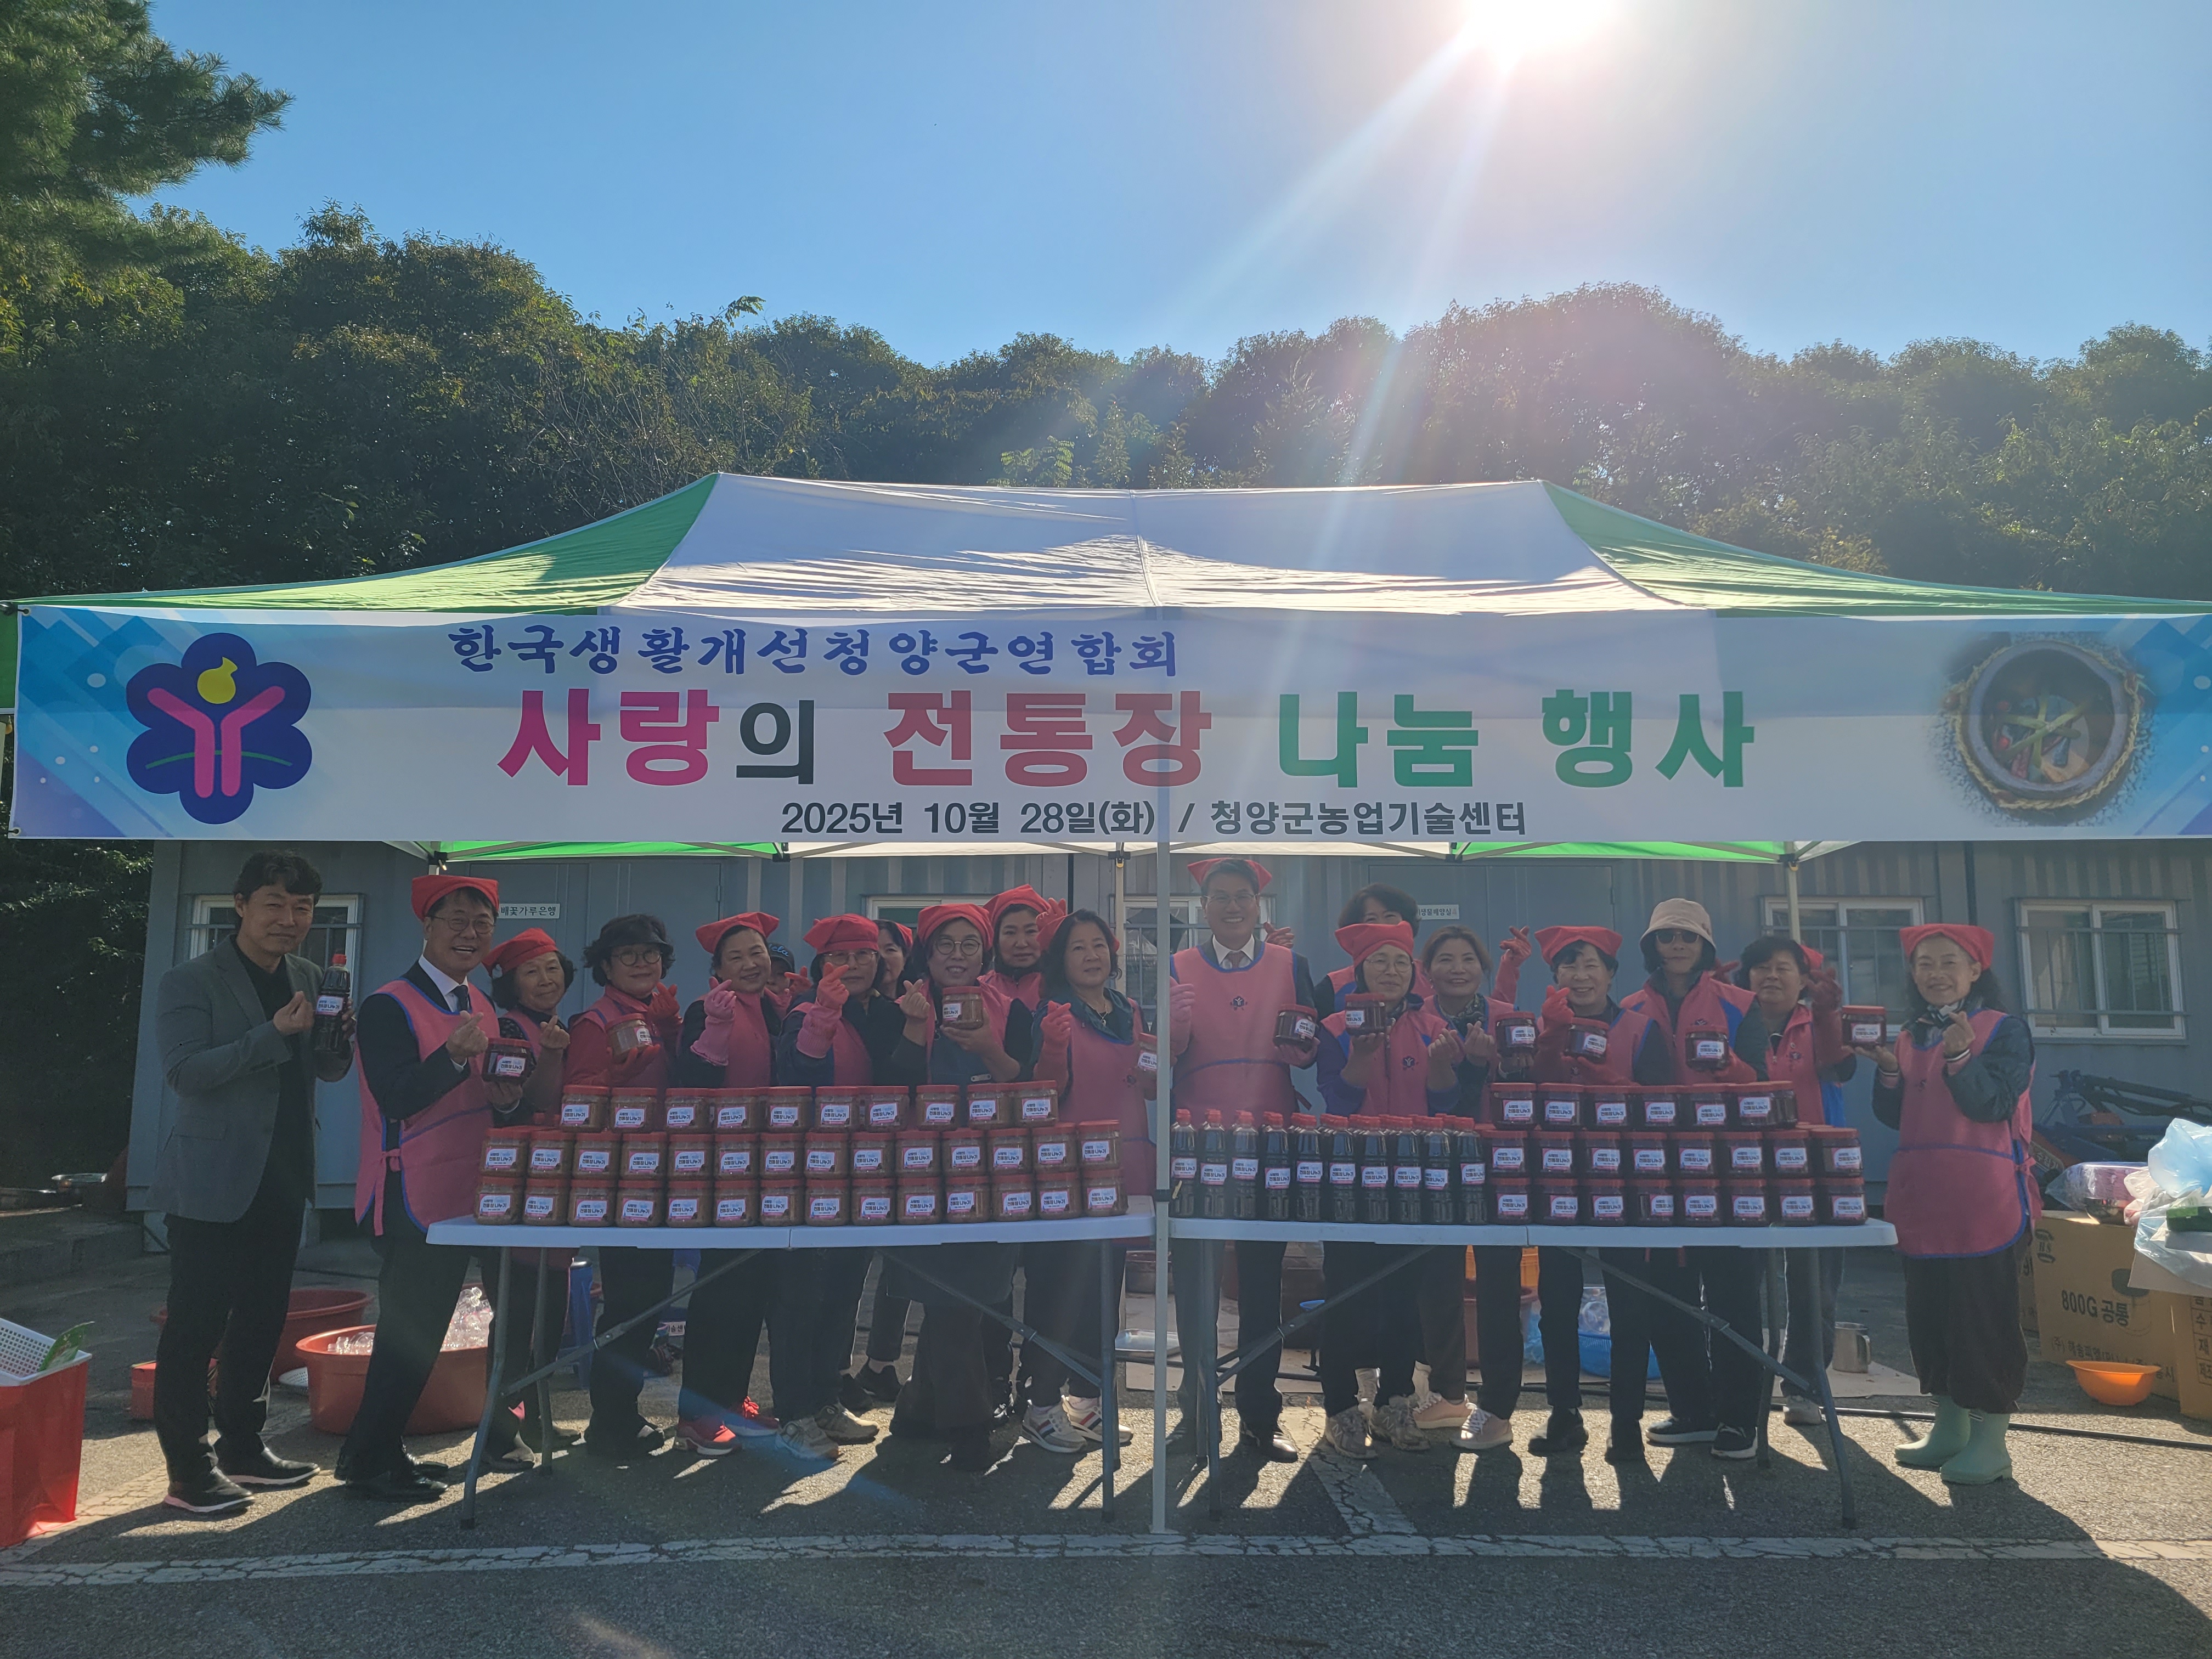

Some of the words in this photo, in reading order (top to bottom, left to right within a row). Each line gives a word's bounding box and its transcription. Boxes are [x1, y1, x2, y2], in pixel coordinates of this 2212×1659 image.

[496, 688, 815, 786] 사랑의
[883, 690, 1212, 787] 전통장
[1279, 690, 1479, 788] 나눔
[1541, 689, 1755, 788] 행사
[781, 802, 903, 834] 2025년
[924, 802, 1000, 834] 10월
[1019, 800, 1155, 836] 28일(화)
[1209, 800, 1527, 836] 청양군농업기술센터
[500, 906, 556, 916] 배꽃가루은행
[2062, 1289, 2098, 1318] 800G
[2101, 1299, 2129, 1327] 공통
